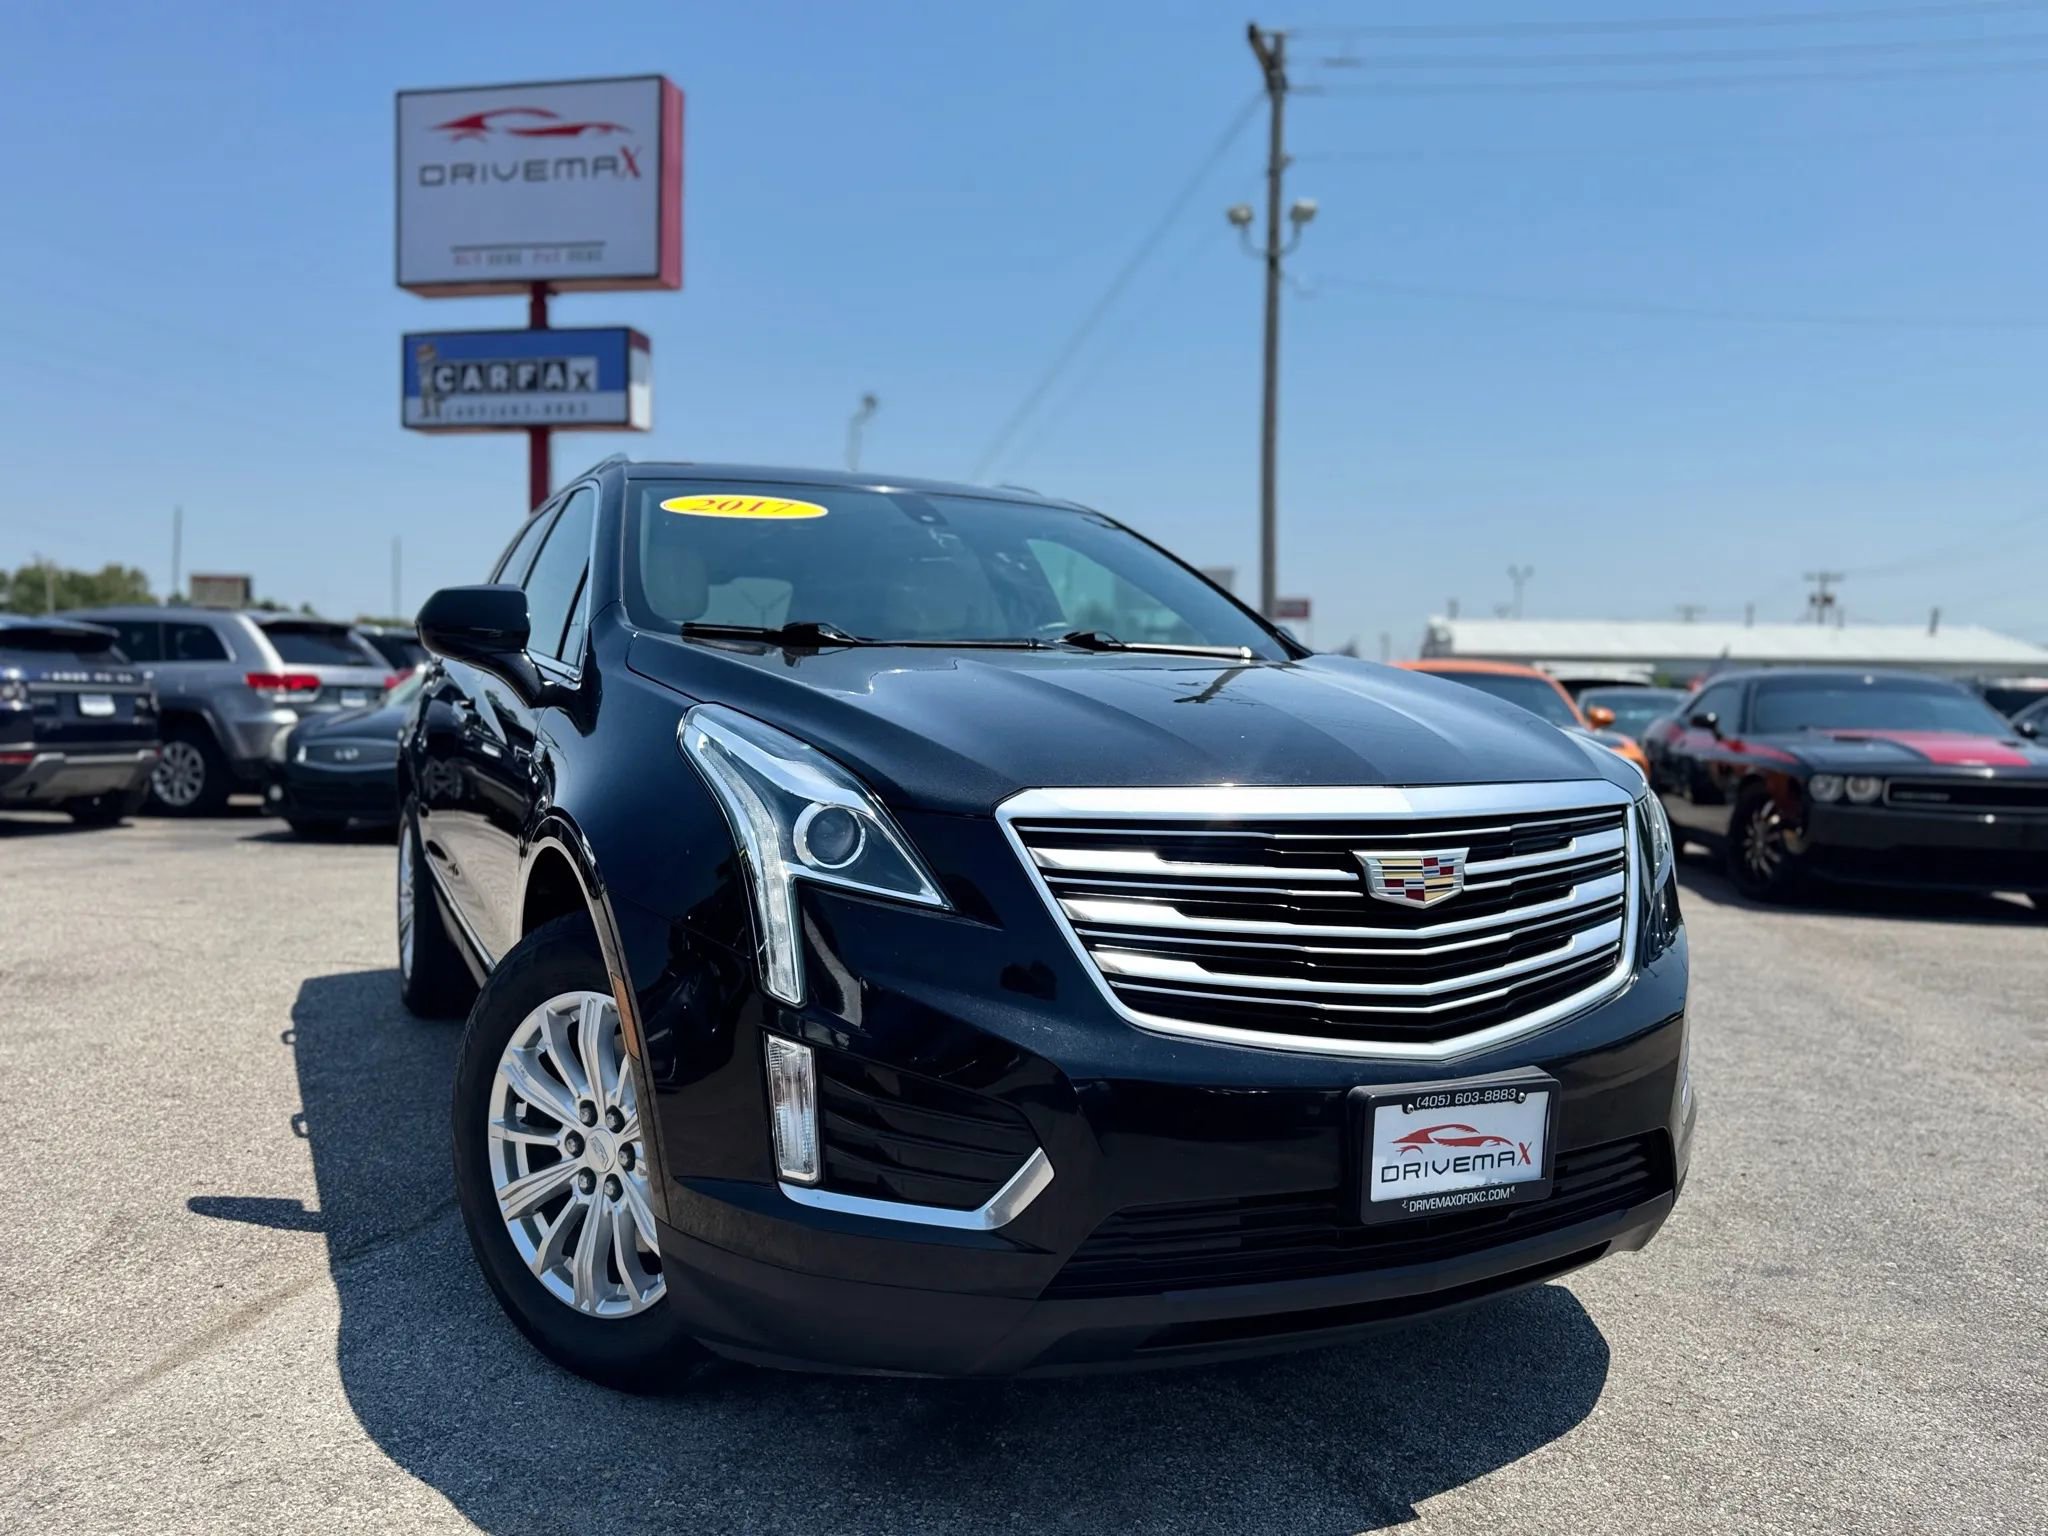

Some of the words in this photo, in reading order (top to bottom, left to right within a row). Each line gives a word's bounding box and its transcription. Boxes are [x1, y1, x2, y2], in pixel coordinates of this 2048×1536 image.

[418, 146, 641, 187] DRIVEMAX
[434, 360, 592, 393] CARFAX
[688, 499, 794, 513] 2017
[1416, 1094, 1450, 1108] (405)
[1454, 1088, 1517, 1105] 603-8883
[1381, 1141, 1532, 1183] DRIVEMAX
[1409, 1190, 1510, 1213] DRIVEMAXOFOKC.COM
